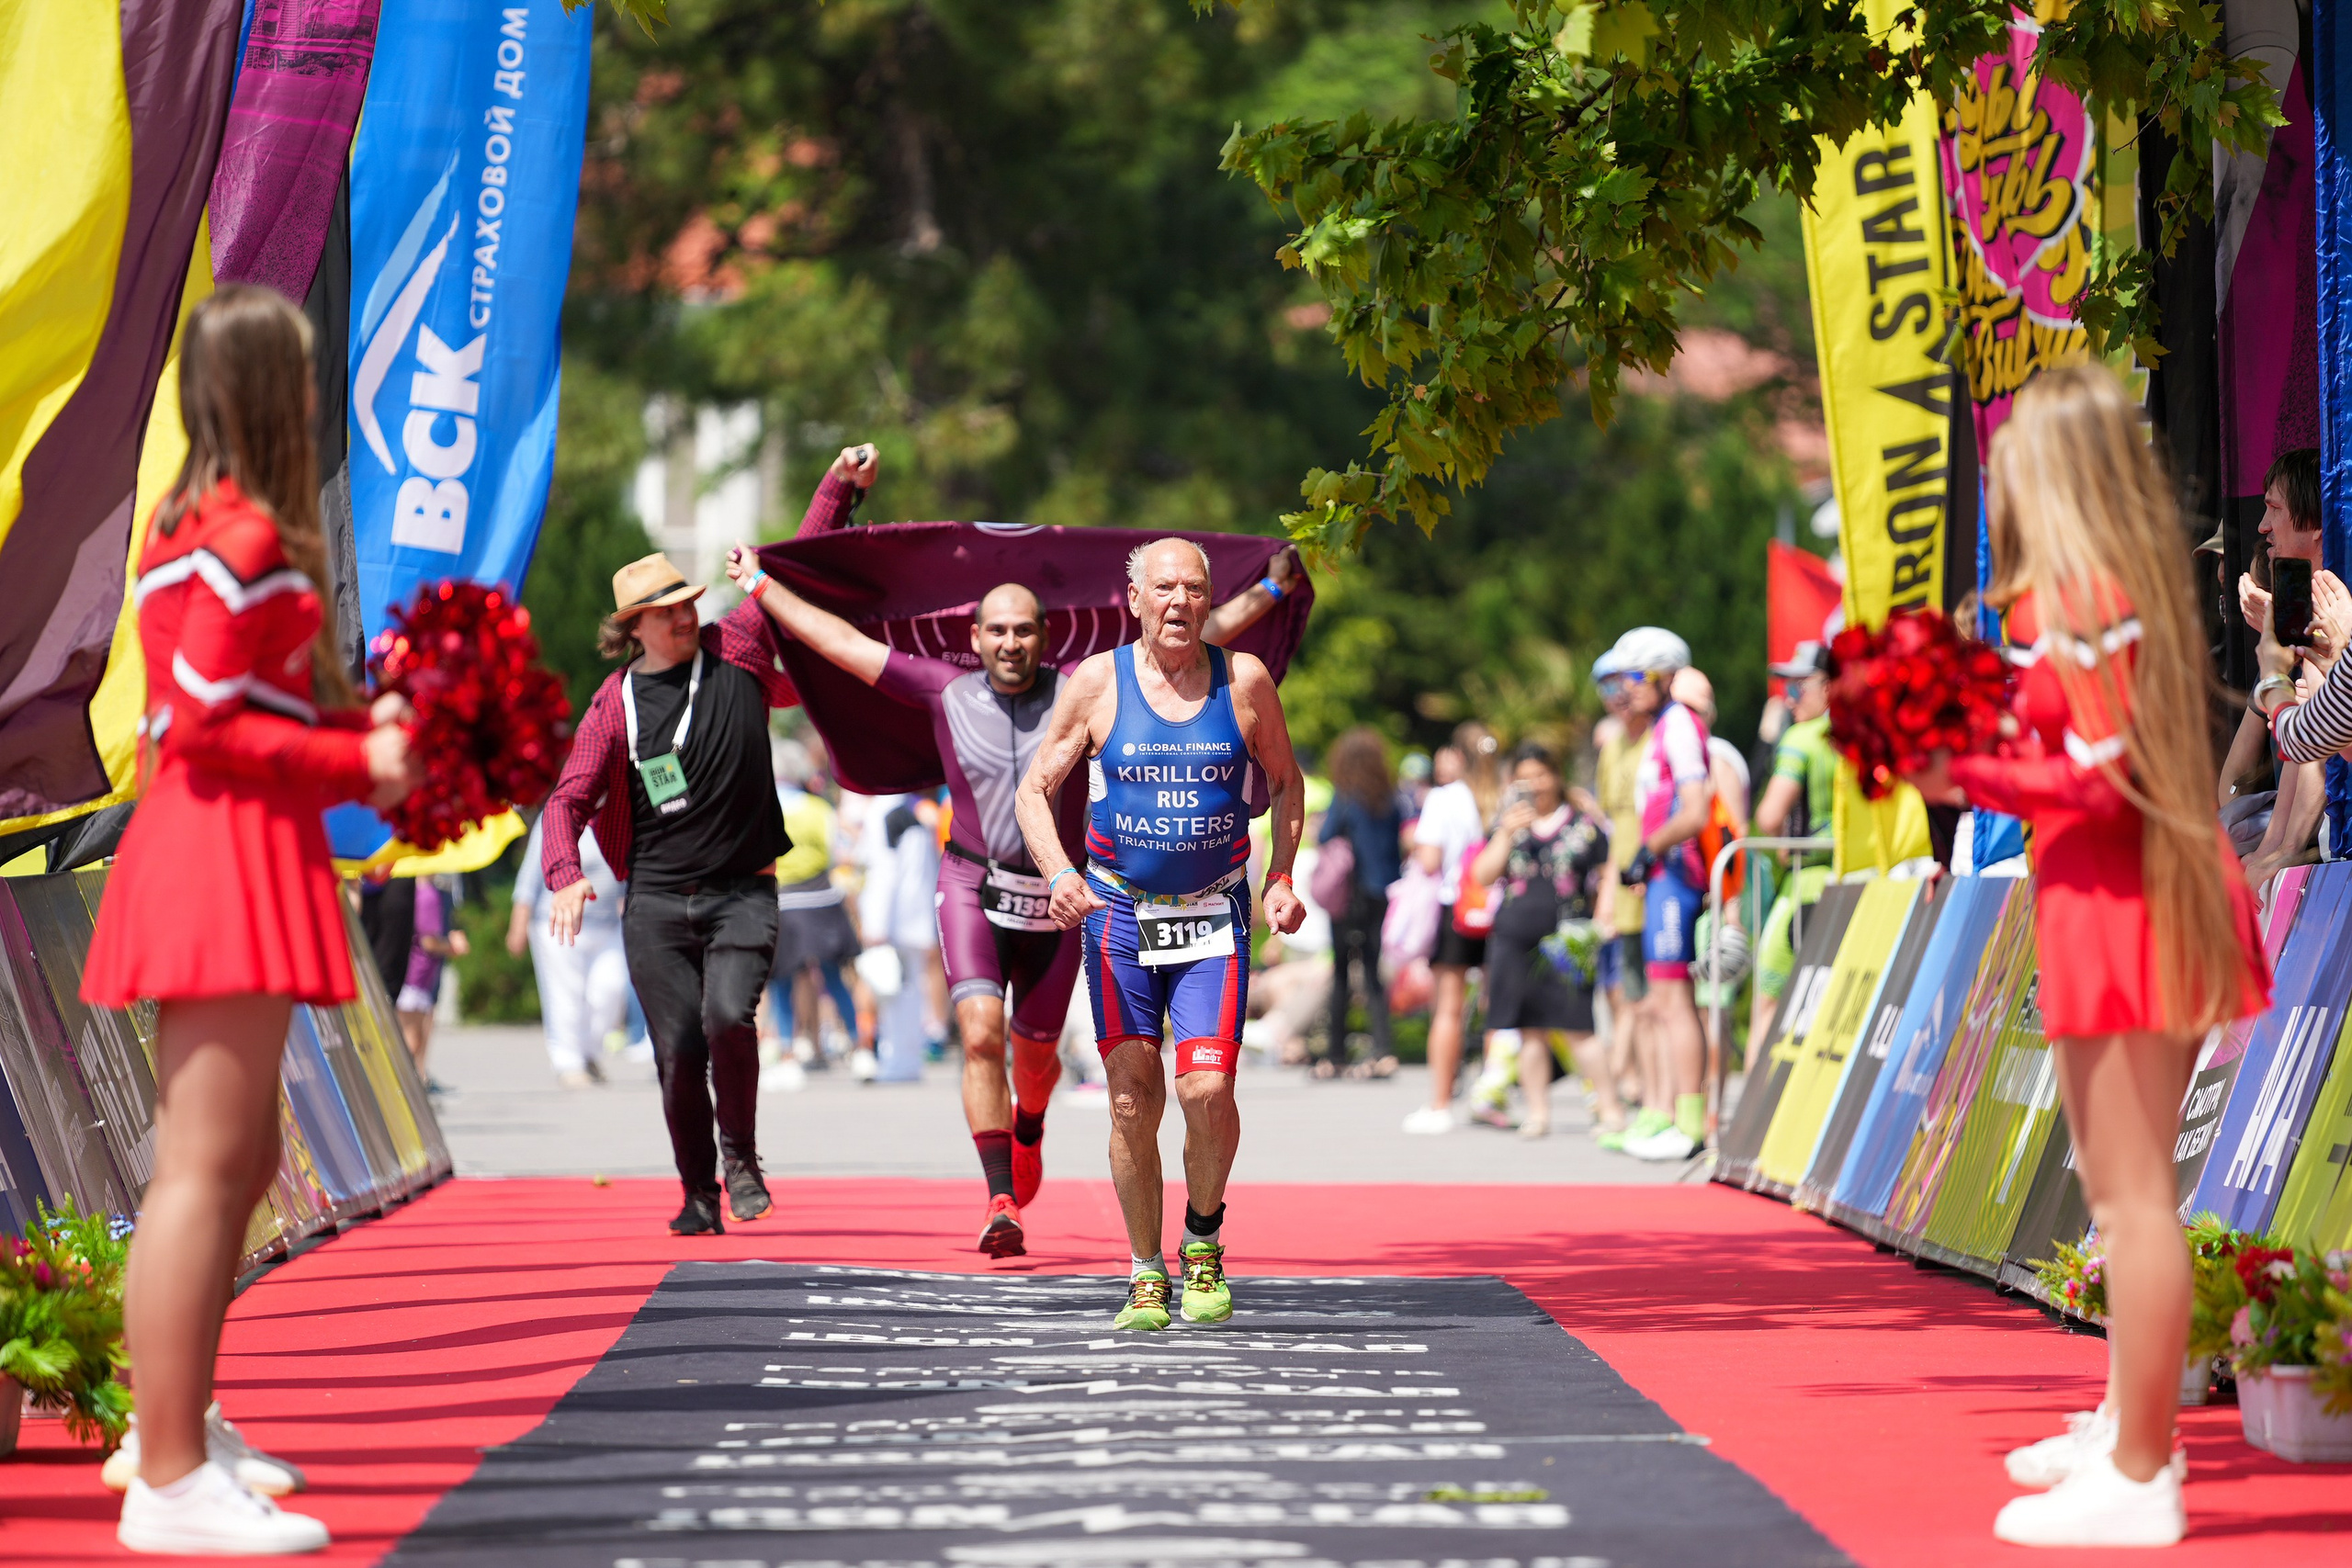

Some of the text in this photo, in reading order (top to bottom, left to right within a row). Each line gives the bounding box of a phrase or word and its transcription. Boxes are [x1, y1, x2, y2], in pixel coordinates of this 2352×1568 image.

[469, 7, 530, 330] СТРАХОВОЙ ДОМ
[1854, 142, 1931, 342] STAR
[390, 323, 488, 556] ВСК
[942, 651, 980, 667] БУДЬ
[1137, 741, 1232, 752] GLOBAL FINANCE
[1117, 765, 1234, 783] KIRILLOV
[1157, 790, 1200, 808] RUS
[1115, 813, 1235, 836] MASTERS
[1117, 833, 1231, 852] TRIATHLON TEAM
[997, 890, 1049, 918] 3139
[1157, 920, 1213, 946] 3119
[782, 1331, 1429, 1352] IRON STAR
[1176, 1381, 1461, 1396] STAR
